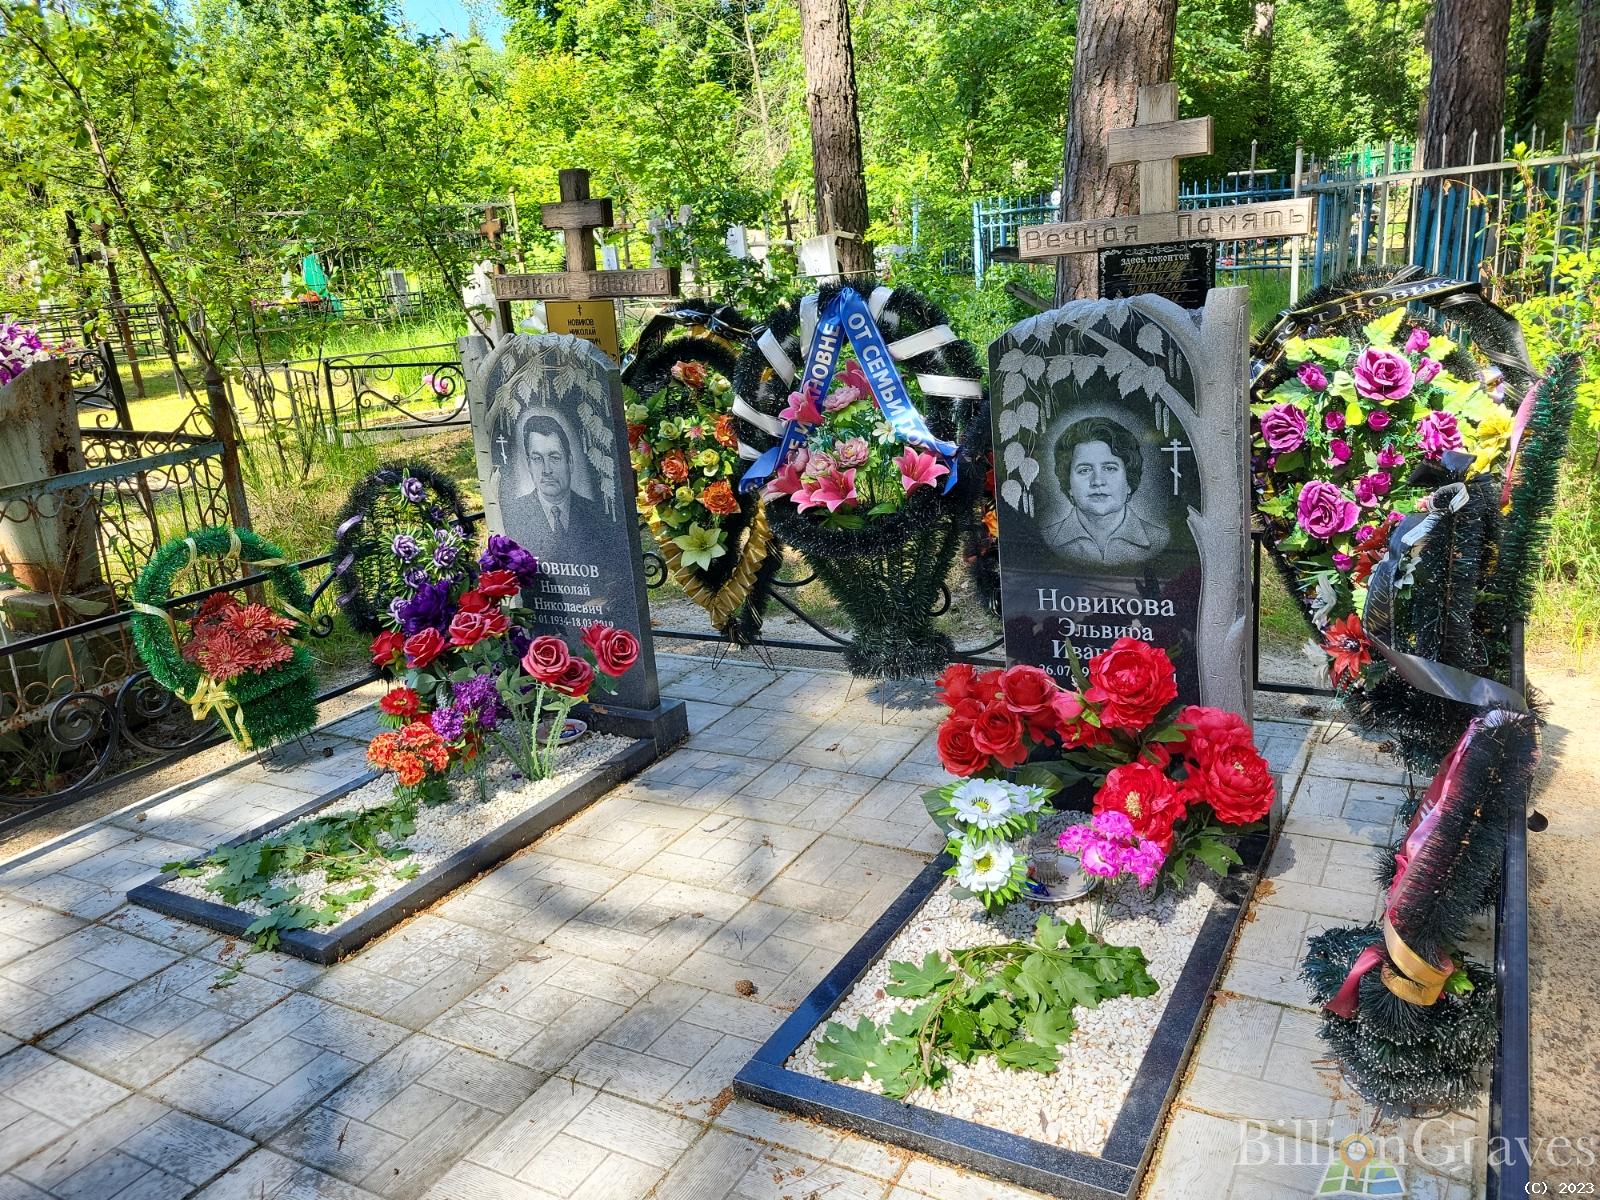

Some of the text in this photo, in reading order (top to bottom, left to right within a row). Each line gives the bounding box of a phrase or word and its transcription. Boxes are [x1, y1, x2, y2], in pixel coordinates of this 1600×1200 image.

[1025, 208, 1305, 251] Вечная Память
[567, 318, 595, 327] НОВИКОВ
[848, 312, 873, 341] ОТ
[862, 346, 907, 417] СЕМЬИ
[793, 323, 842, 435] ИНОВНЕ
[541, 580, 591, 596] Николай
[534, 597, 604, 615] Николаевич
[1036, 588, 1176, 618] Новикова
[1057, 617, 1154, 642] Эльвира
